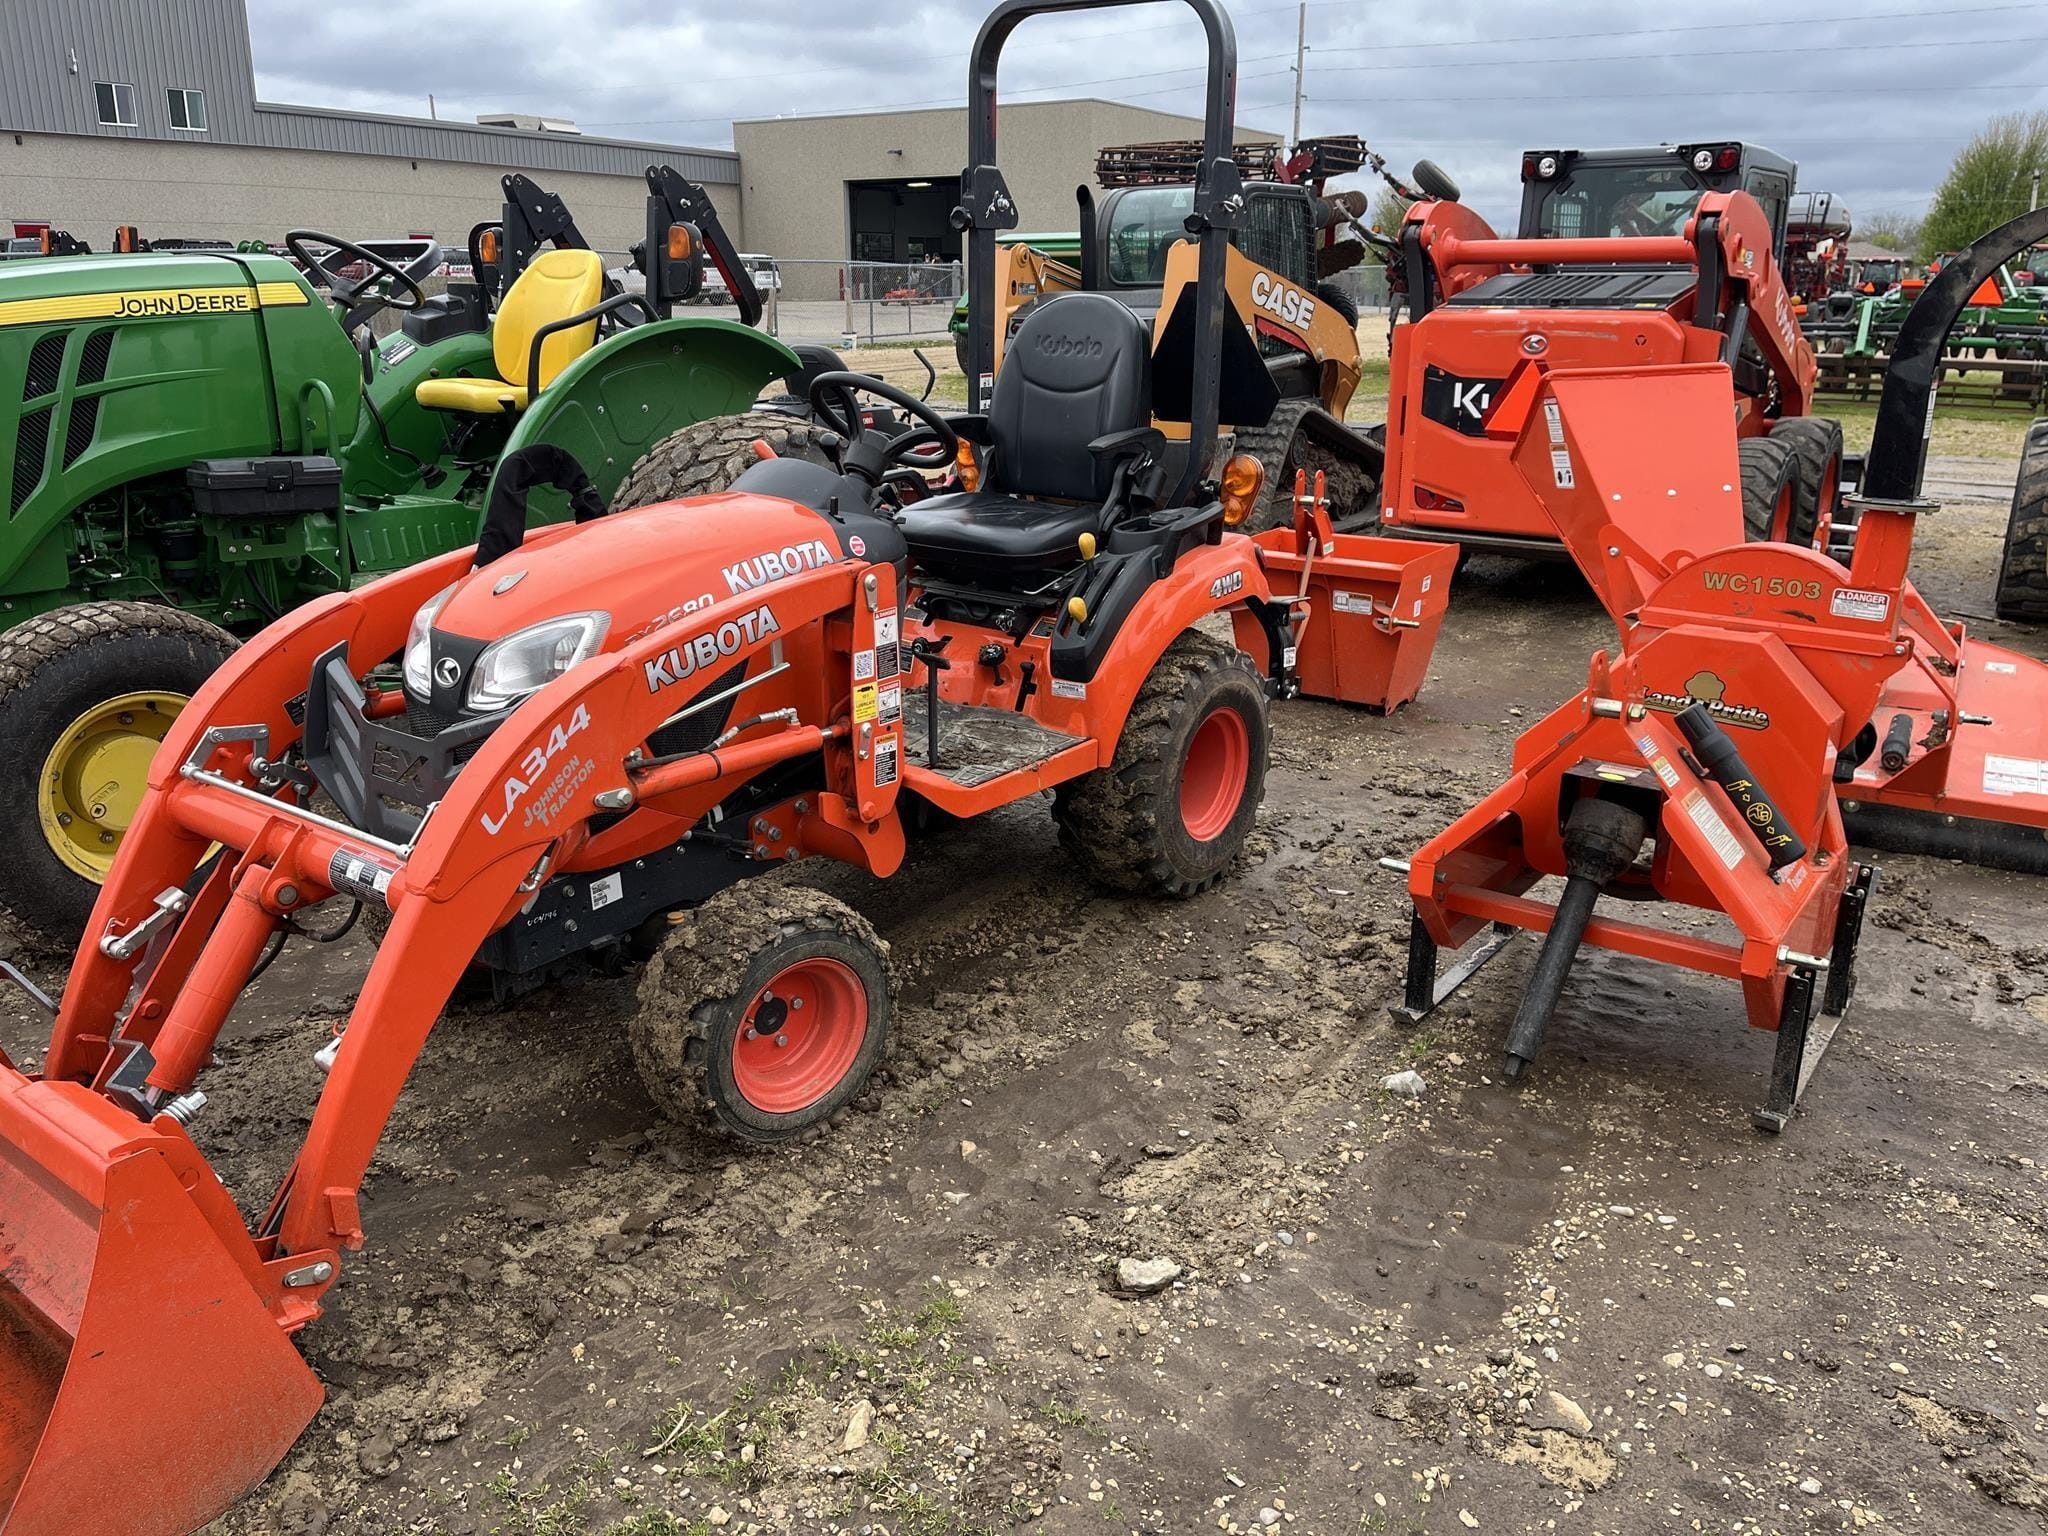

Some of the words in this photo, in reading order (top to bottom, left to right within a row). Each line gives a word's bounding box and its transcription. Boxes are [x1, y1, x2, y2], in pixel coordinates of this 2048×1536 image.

[113, 296, 175, 315] JOHN
[177, 293, 249, 312] DEERE
[1251, 271, 1316, 331] CASE
[1034, 333, 1104, 358] Kubota
[721, 538, 836, 596] KUBOTA
[1209, 569, 1243, 599] 4WD
[1703, 570, 1823, 600] WC1503
[1846, 591, 1887, 606] DANGER
[643, 603, 782, 695] KUBOTA
[1707, 698, 1769, 725] Pride
[480, 702, 592, 836] LA344
[523, 754, 581, 828] JOHNSON
[537, 757, 597, 827] TRACTOR
